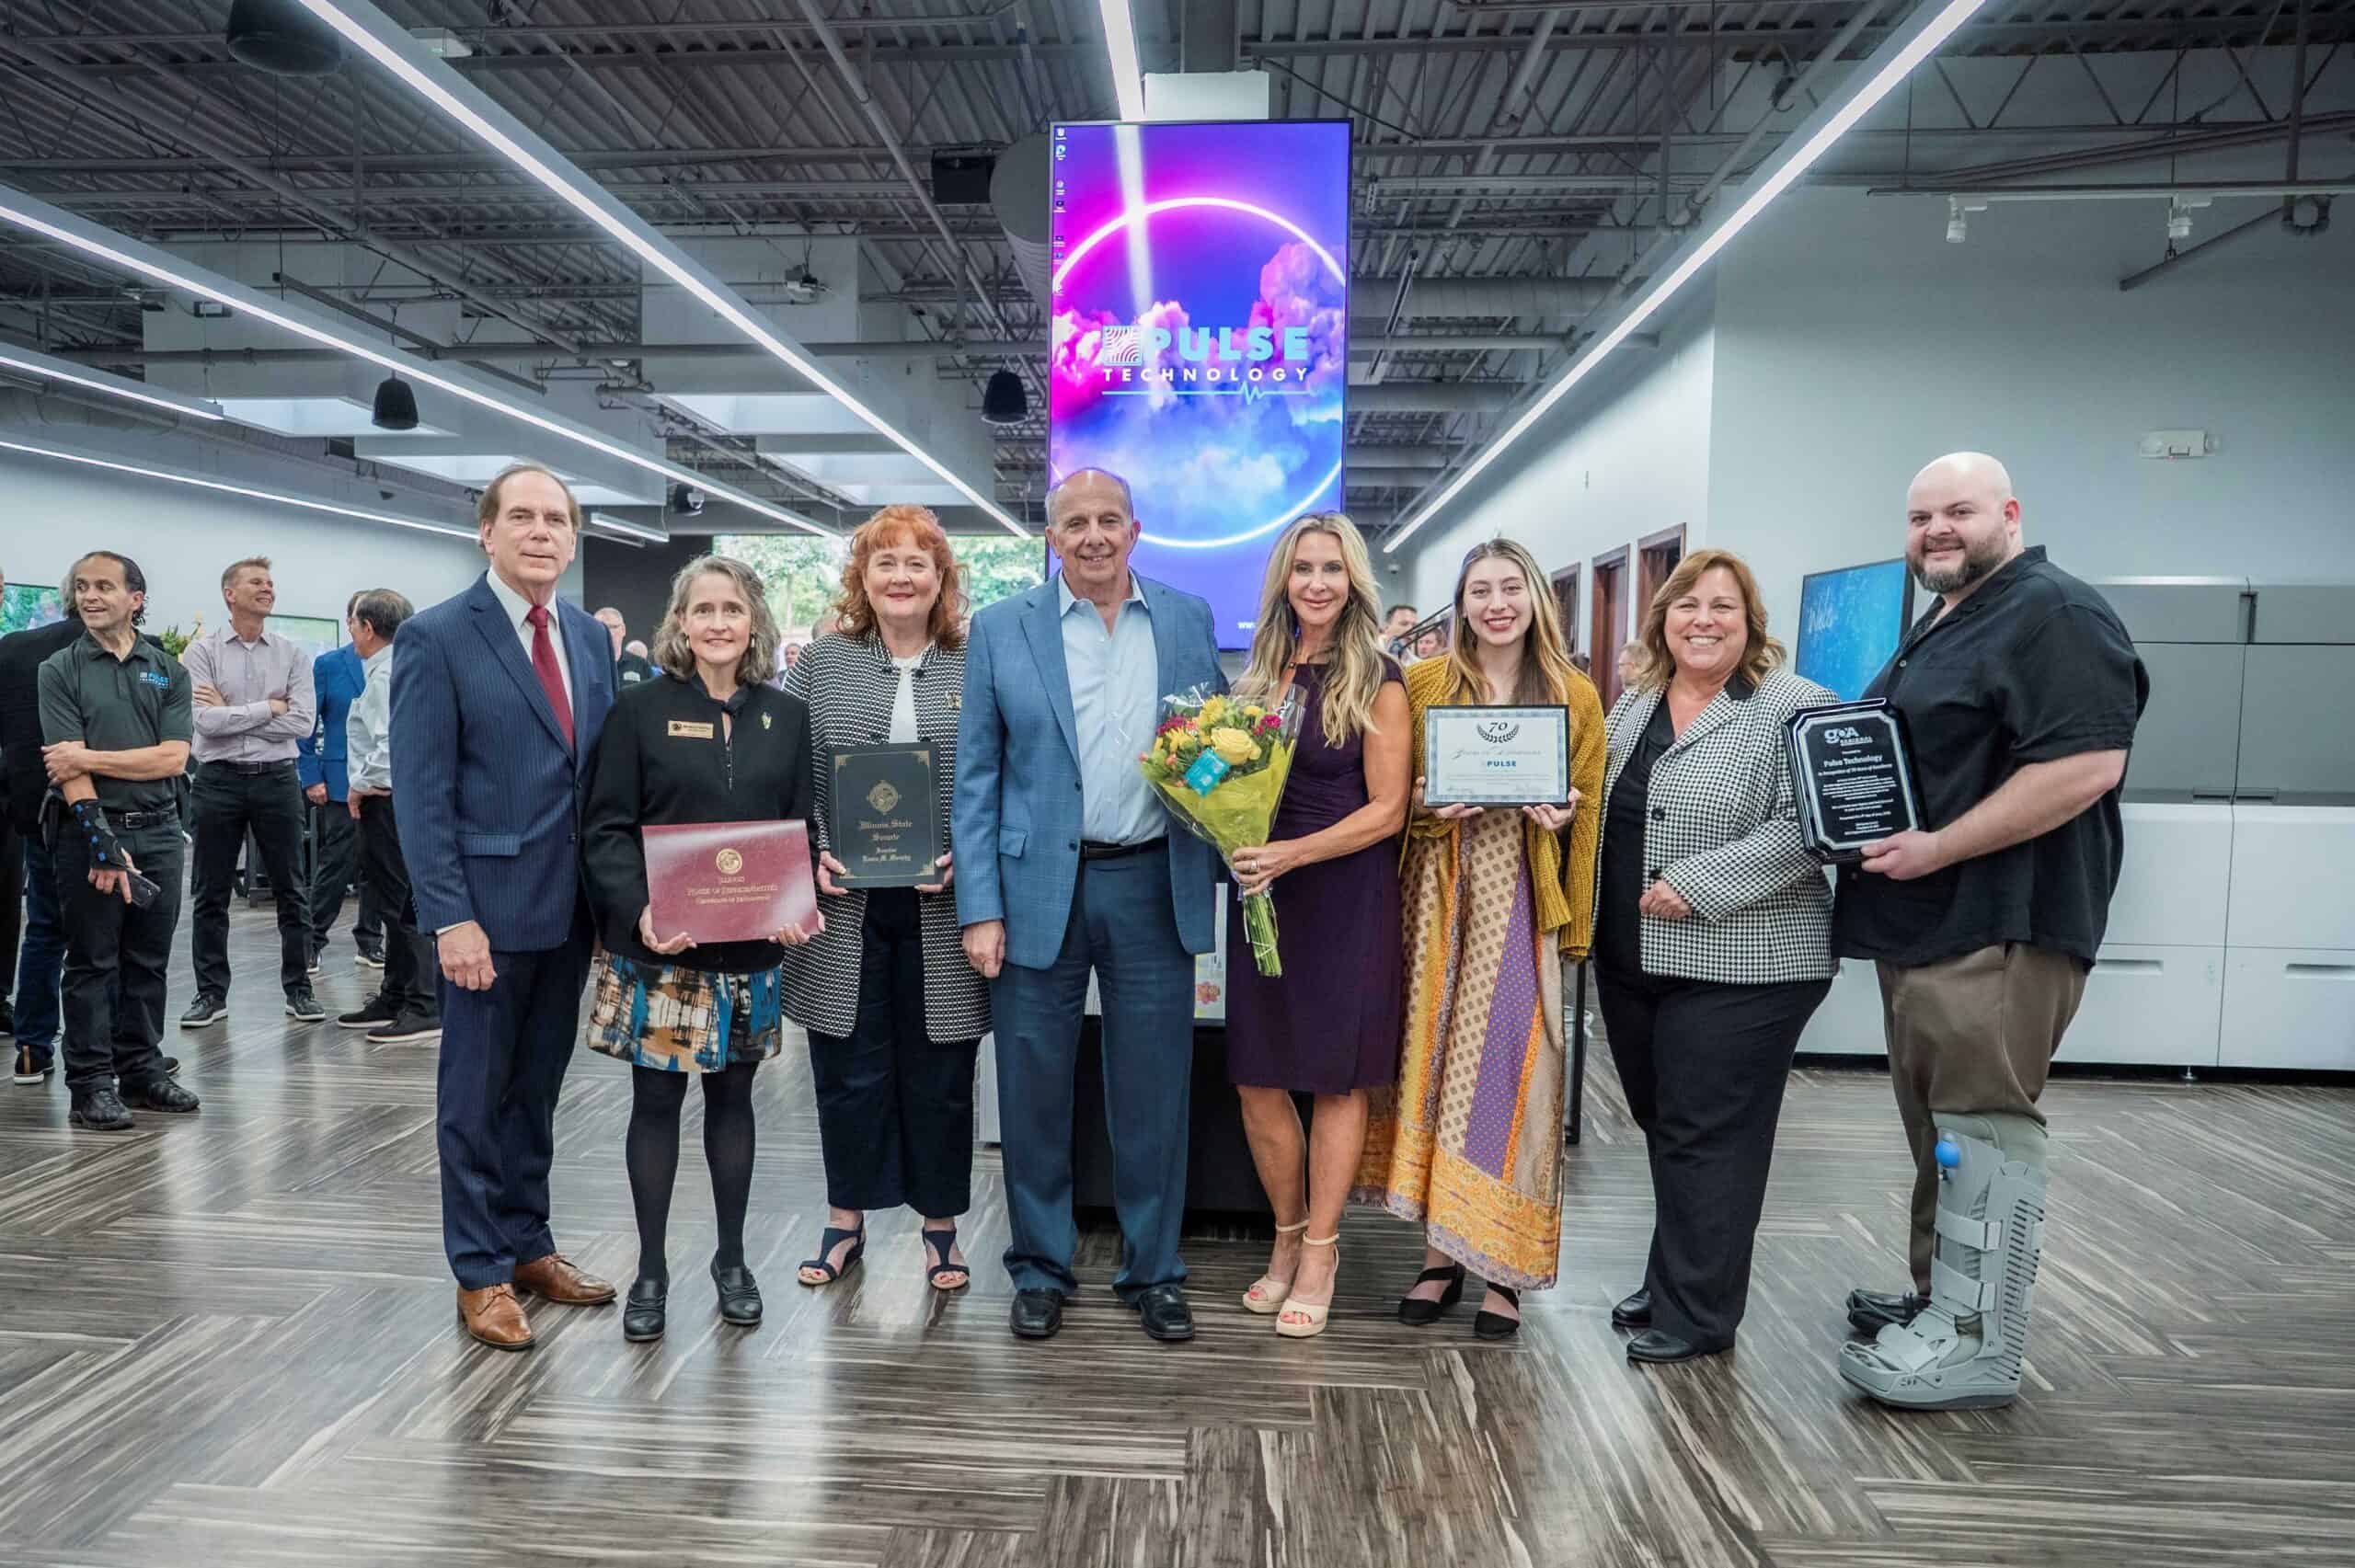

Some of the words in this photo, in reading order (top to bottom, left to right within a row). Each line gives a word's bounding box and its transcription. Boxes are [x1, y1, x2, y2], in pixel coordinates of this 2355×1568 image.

[1143, 326, 1308, 361] PULSE
[1104, 368, 1308, 382] TECHNOLOGY
[1488, 722, 1509, 733] 70
